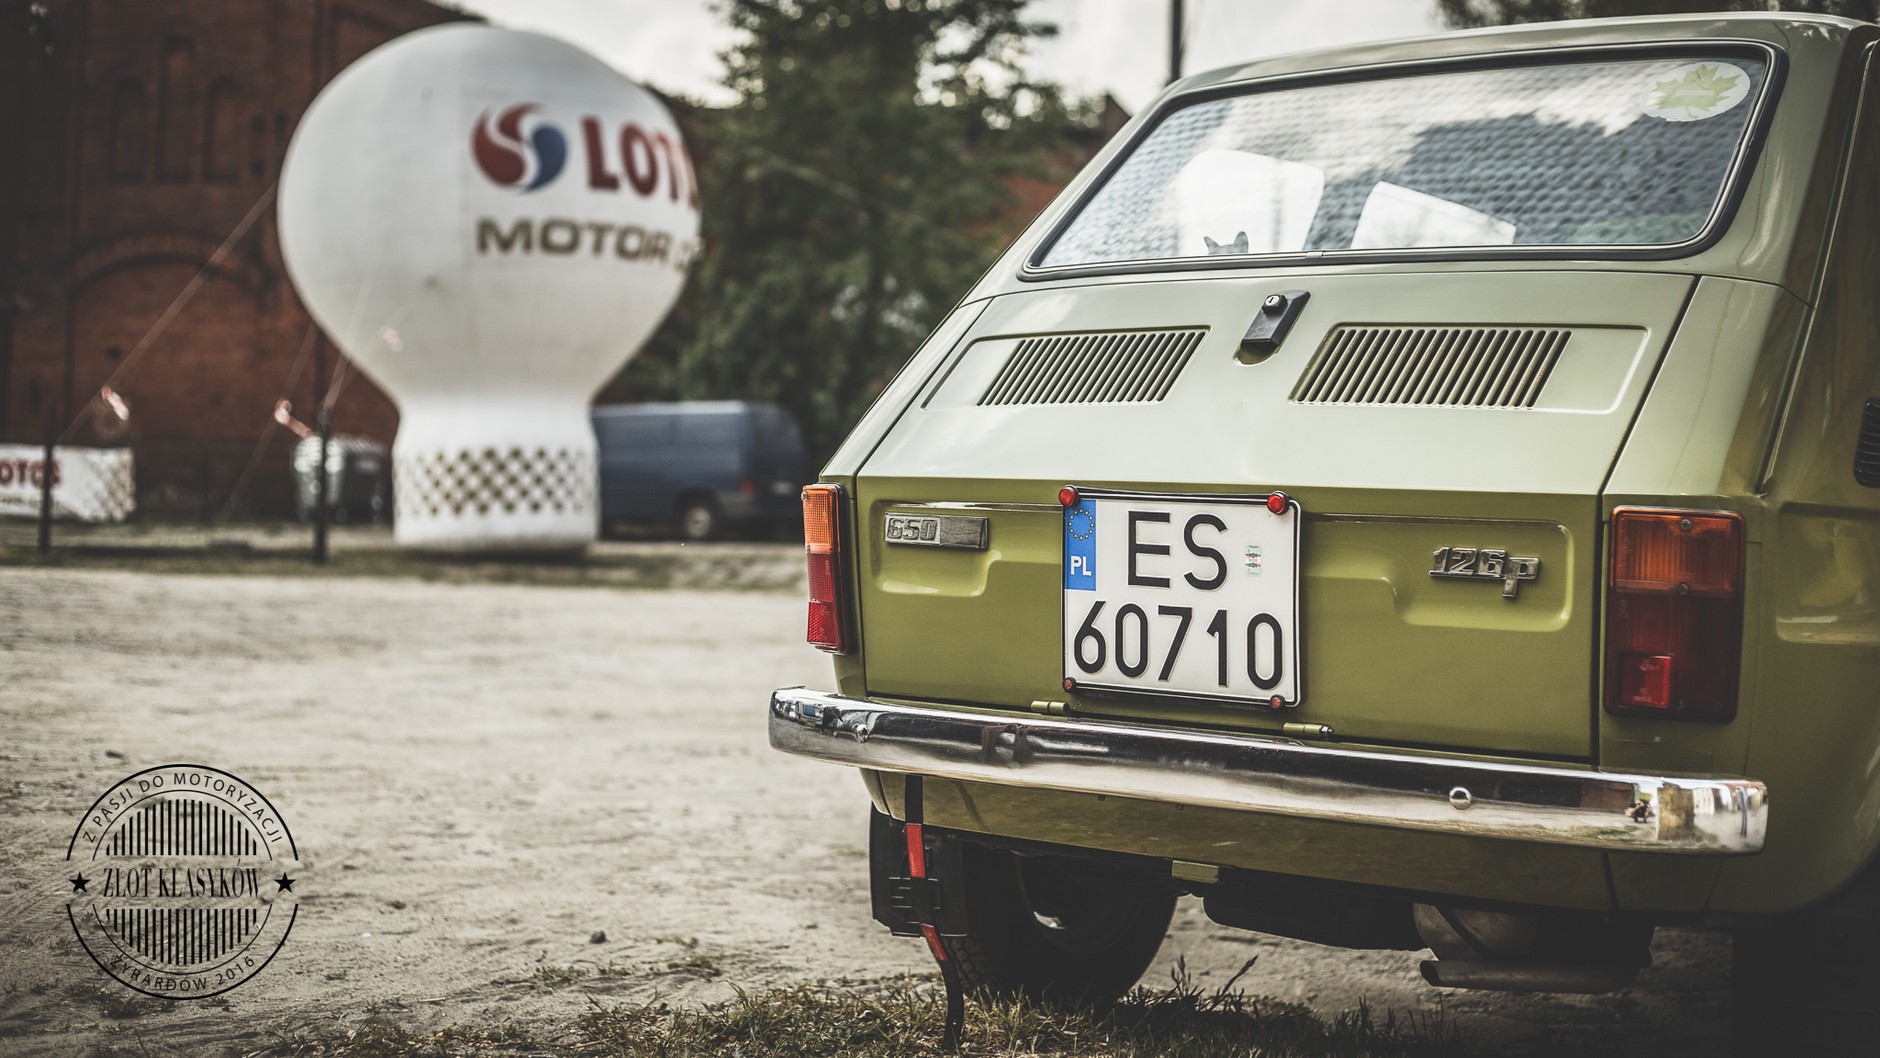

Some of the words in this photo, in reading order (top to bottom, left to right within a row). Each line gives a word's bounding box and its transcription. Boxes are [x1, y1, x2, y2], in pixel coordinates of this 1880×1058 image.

[476, 216, 672, 265] MOTOR
[886, 517, 938, 541] 650
[1128, 510, 1228, 591] ES
[1070, 555, 1092, 577] PL
[1073, 600, 1283, 691] 60710
